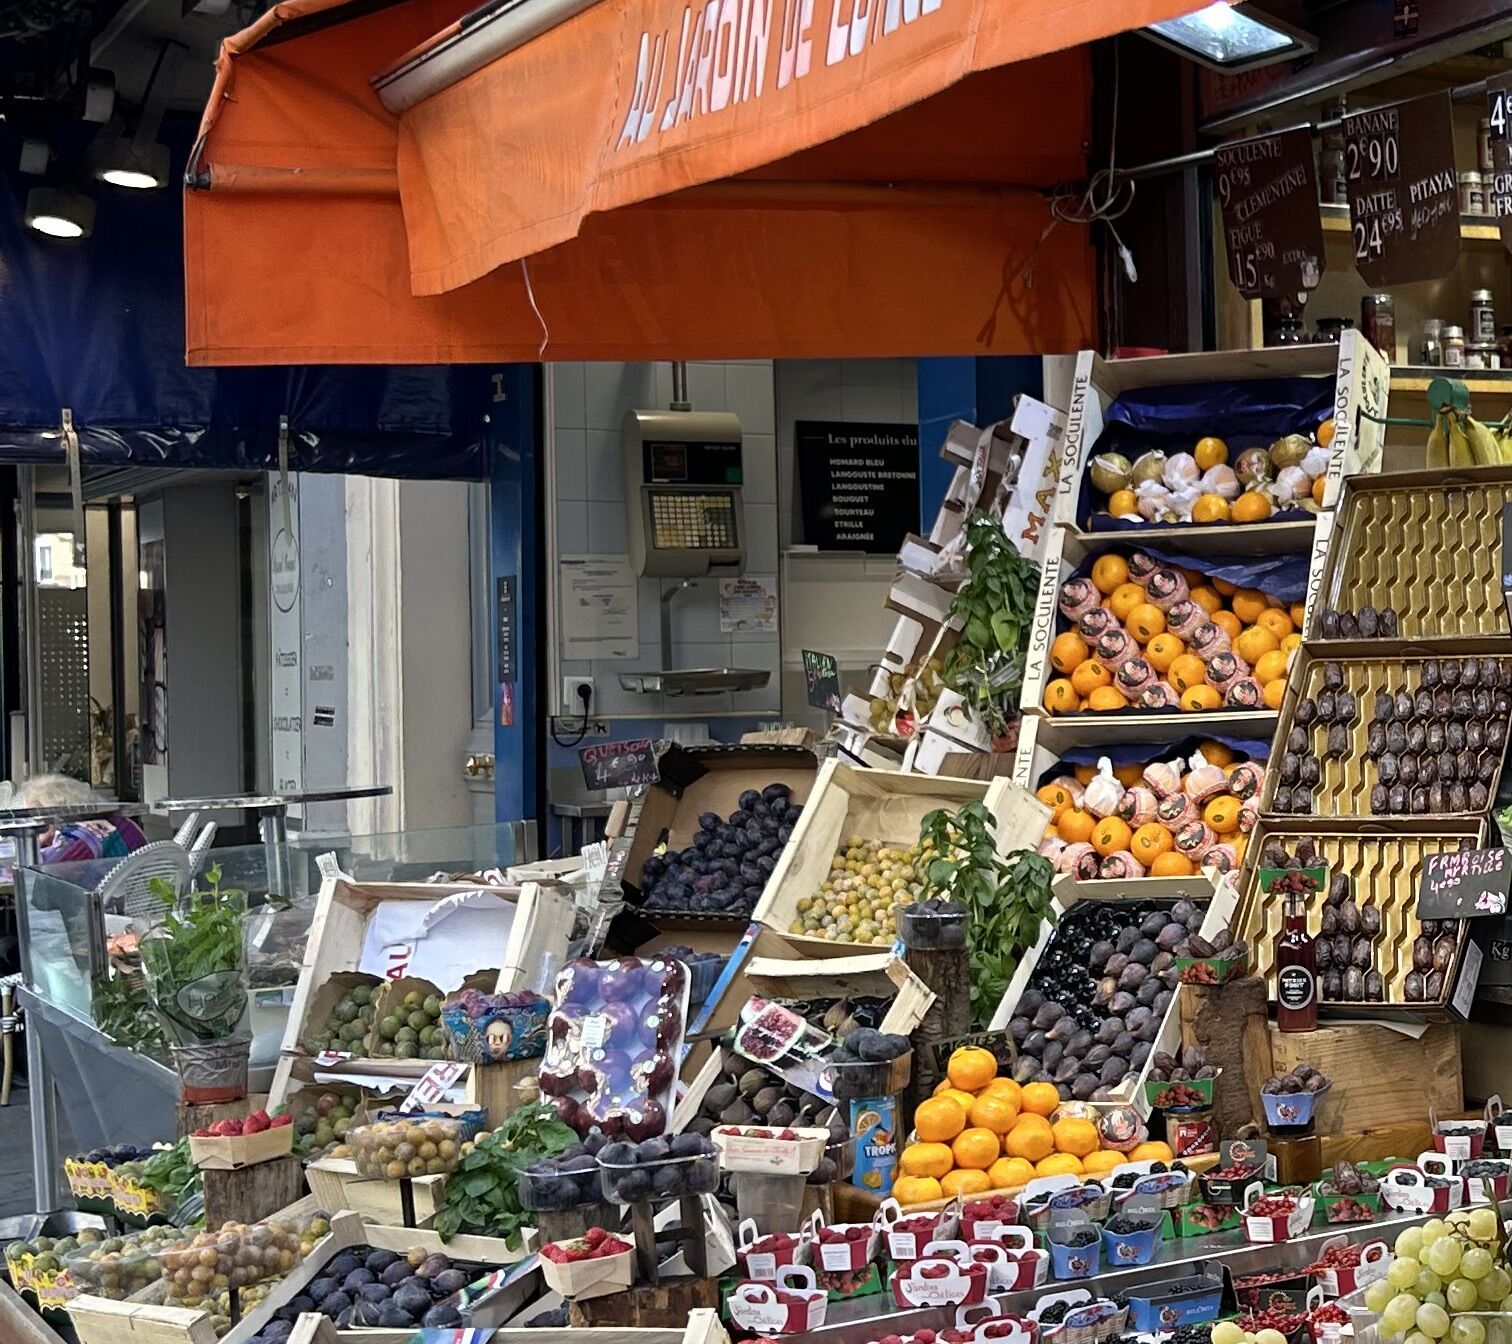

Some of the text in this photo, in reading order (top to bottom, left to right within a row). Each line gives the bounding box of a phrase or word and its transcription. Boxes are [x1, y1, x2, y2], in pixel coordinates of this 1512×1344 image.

[616, 31, 669, 154] AU
[1347, 112, 1398, 136] BANANE
[1217, 137, 1281, 167] SOCULENTE
[1348, 137, 1398, 179] 2€90
[1236, 165, 1307, 221] CLEMENTINE
[1409, 171, 1454, 203] PITAYA
[1357, 191, 1394, 216] DATTE
[1229, 224, 1263, 250] FIGUE
[828, 433, 917, 448] Les produits du
[1059, 374, 1089, 495] LA SOCULENTE
[1021, 449, 1063, 545] MAX
[1027, 555, 1060, 681] LA SOCULENTE
[1492, 942, 1509, 960] Kg
